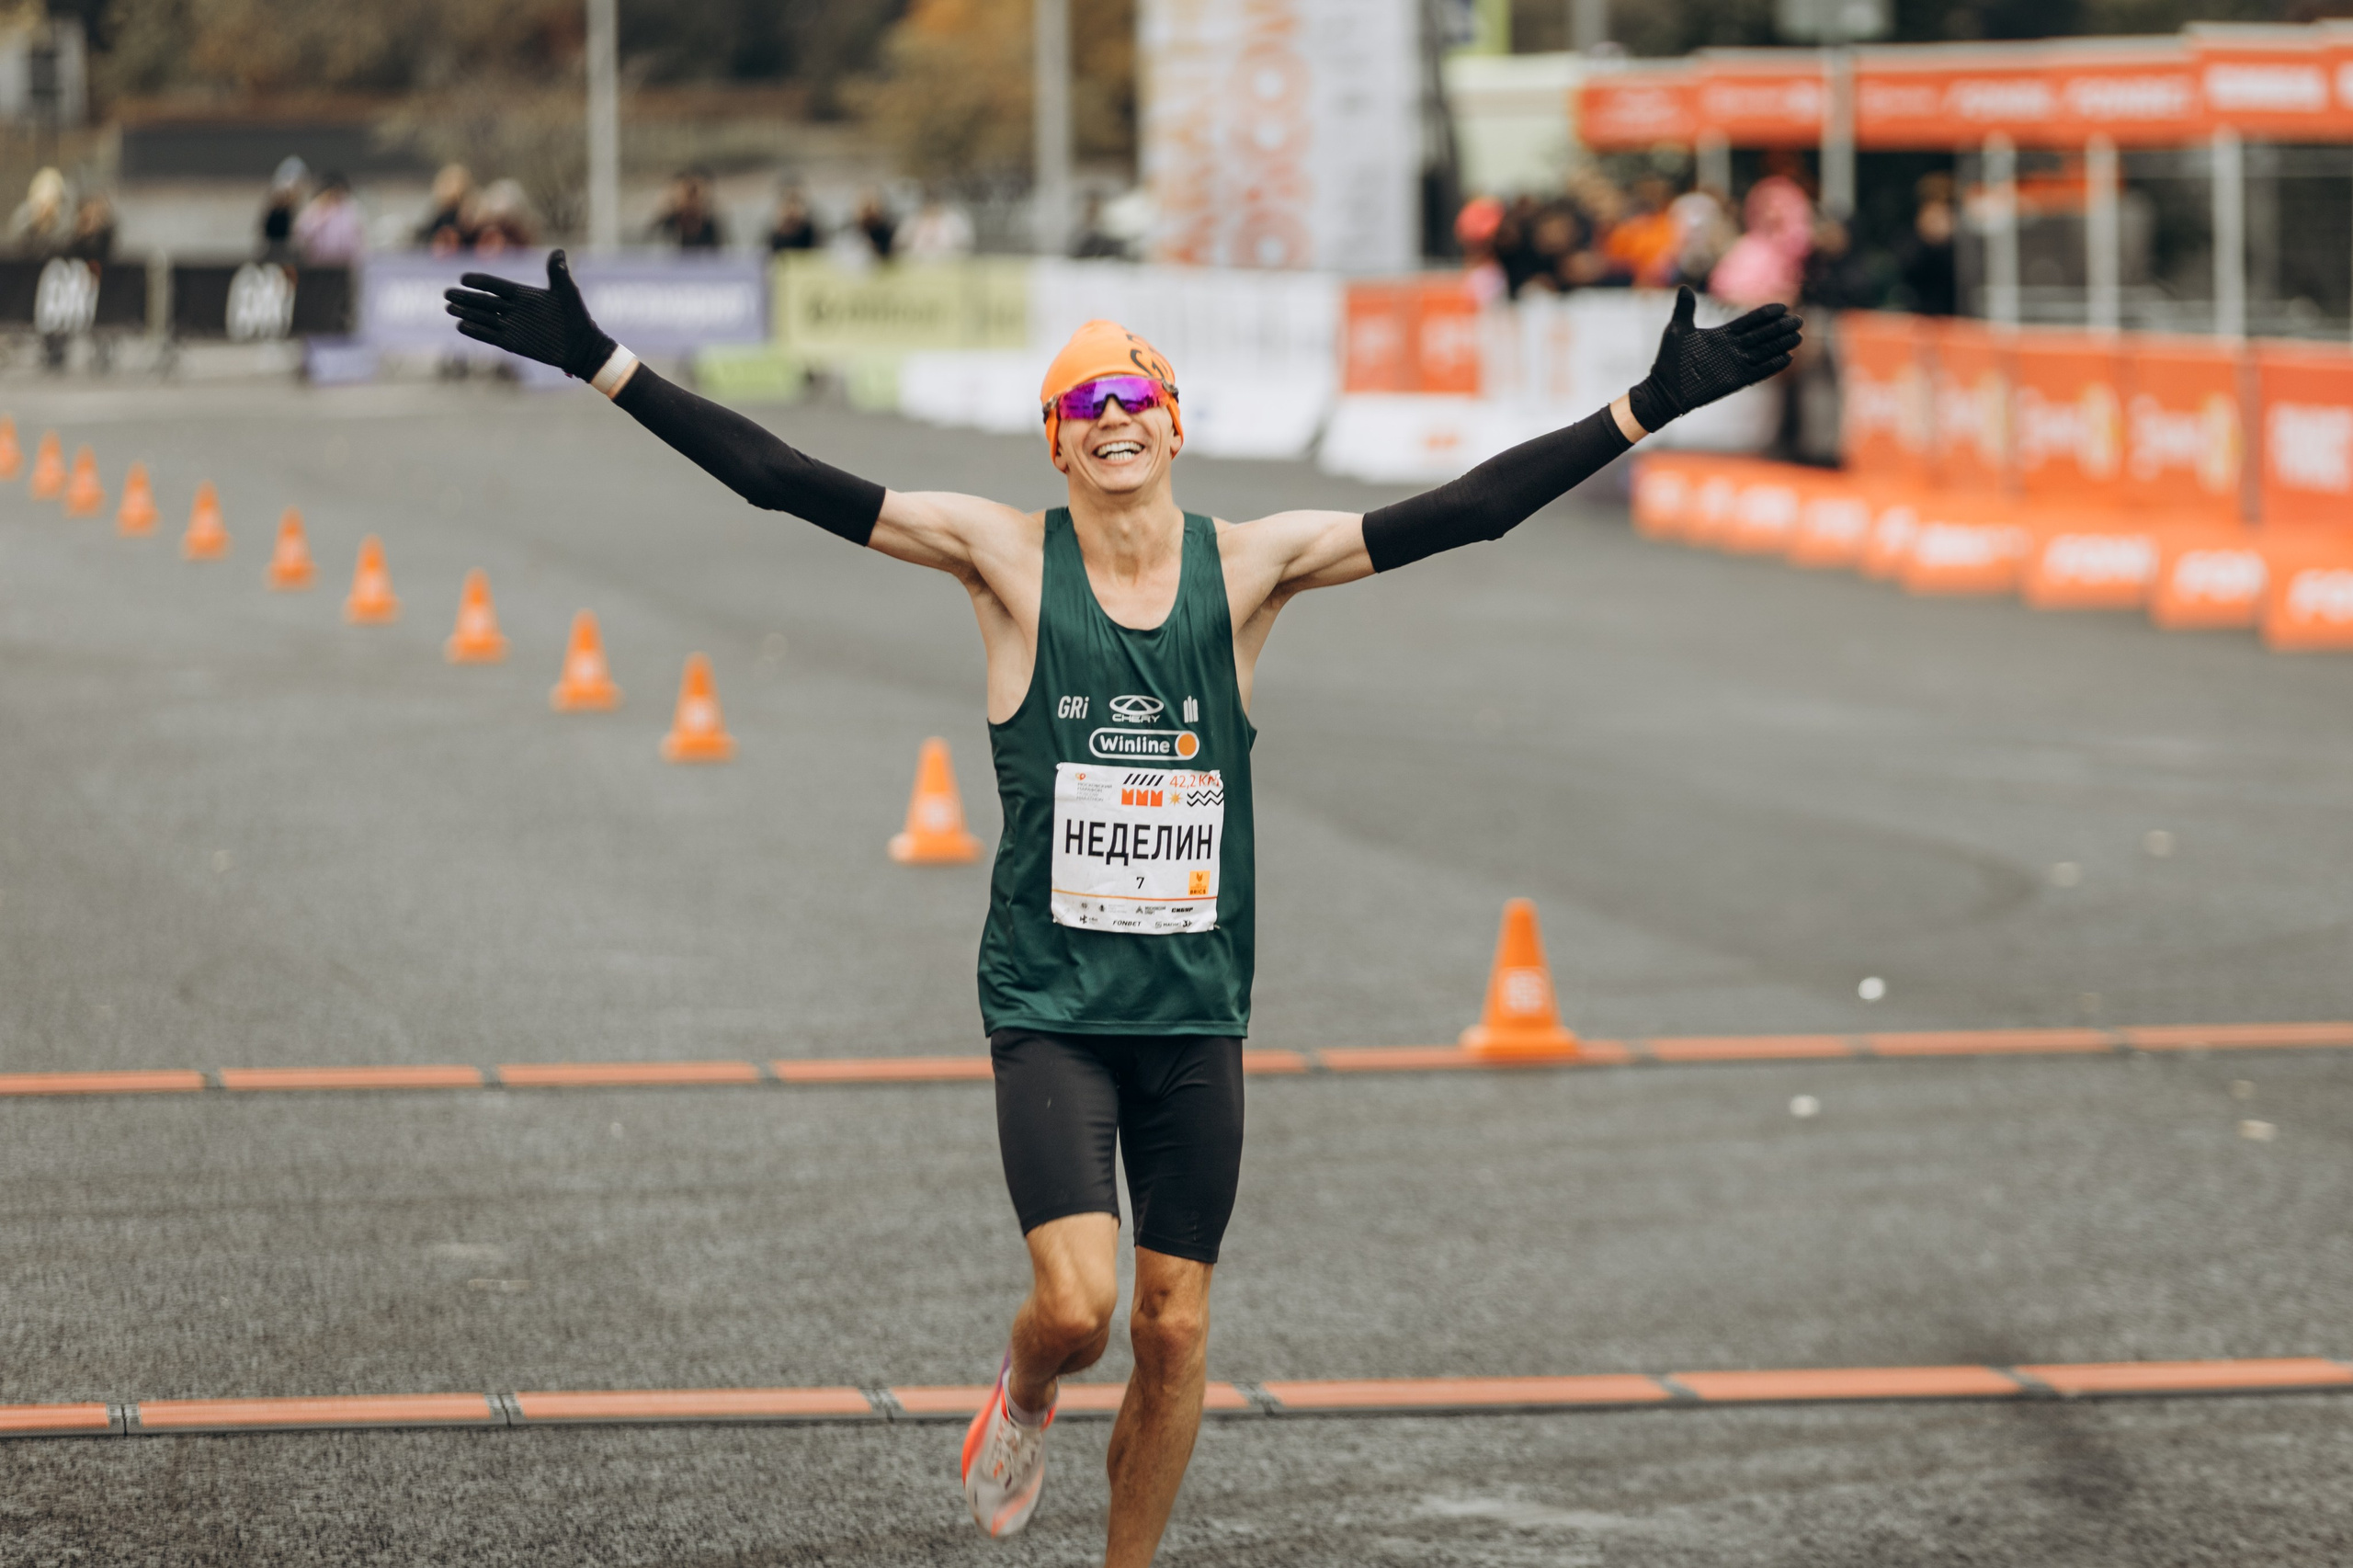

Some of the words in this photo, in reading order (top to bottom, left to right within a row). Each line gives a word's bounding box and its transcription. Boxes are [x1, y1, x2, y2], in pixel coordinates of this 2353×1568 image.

[1058, 696, 1089, 719] GRi
[1112, 714, 1160, 723] CHERY
[1100, 735, 1170, 753] Winline
[1170, 775, 1196, 789] 42,2
[1065, 819, 1212, 866] НЕДЕЛИН
[1136, 877, 1144, 889] 7
